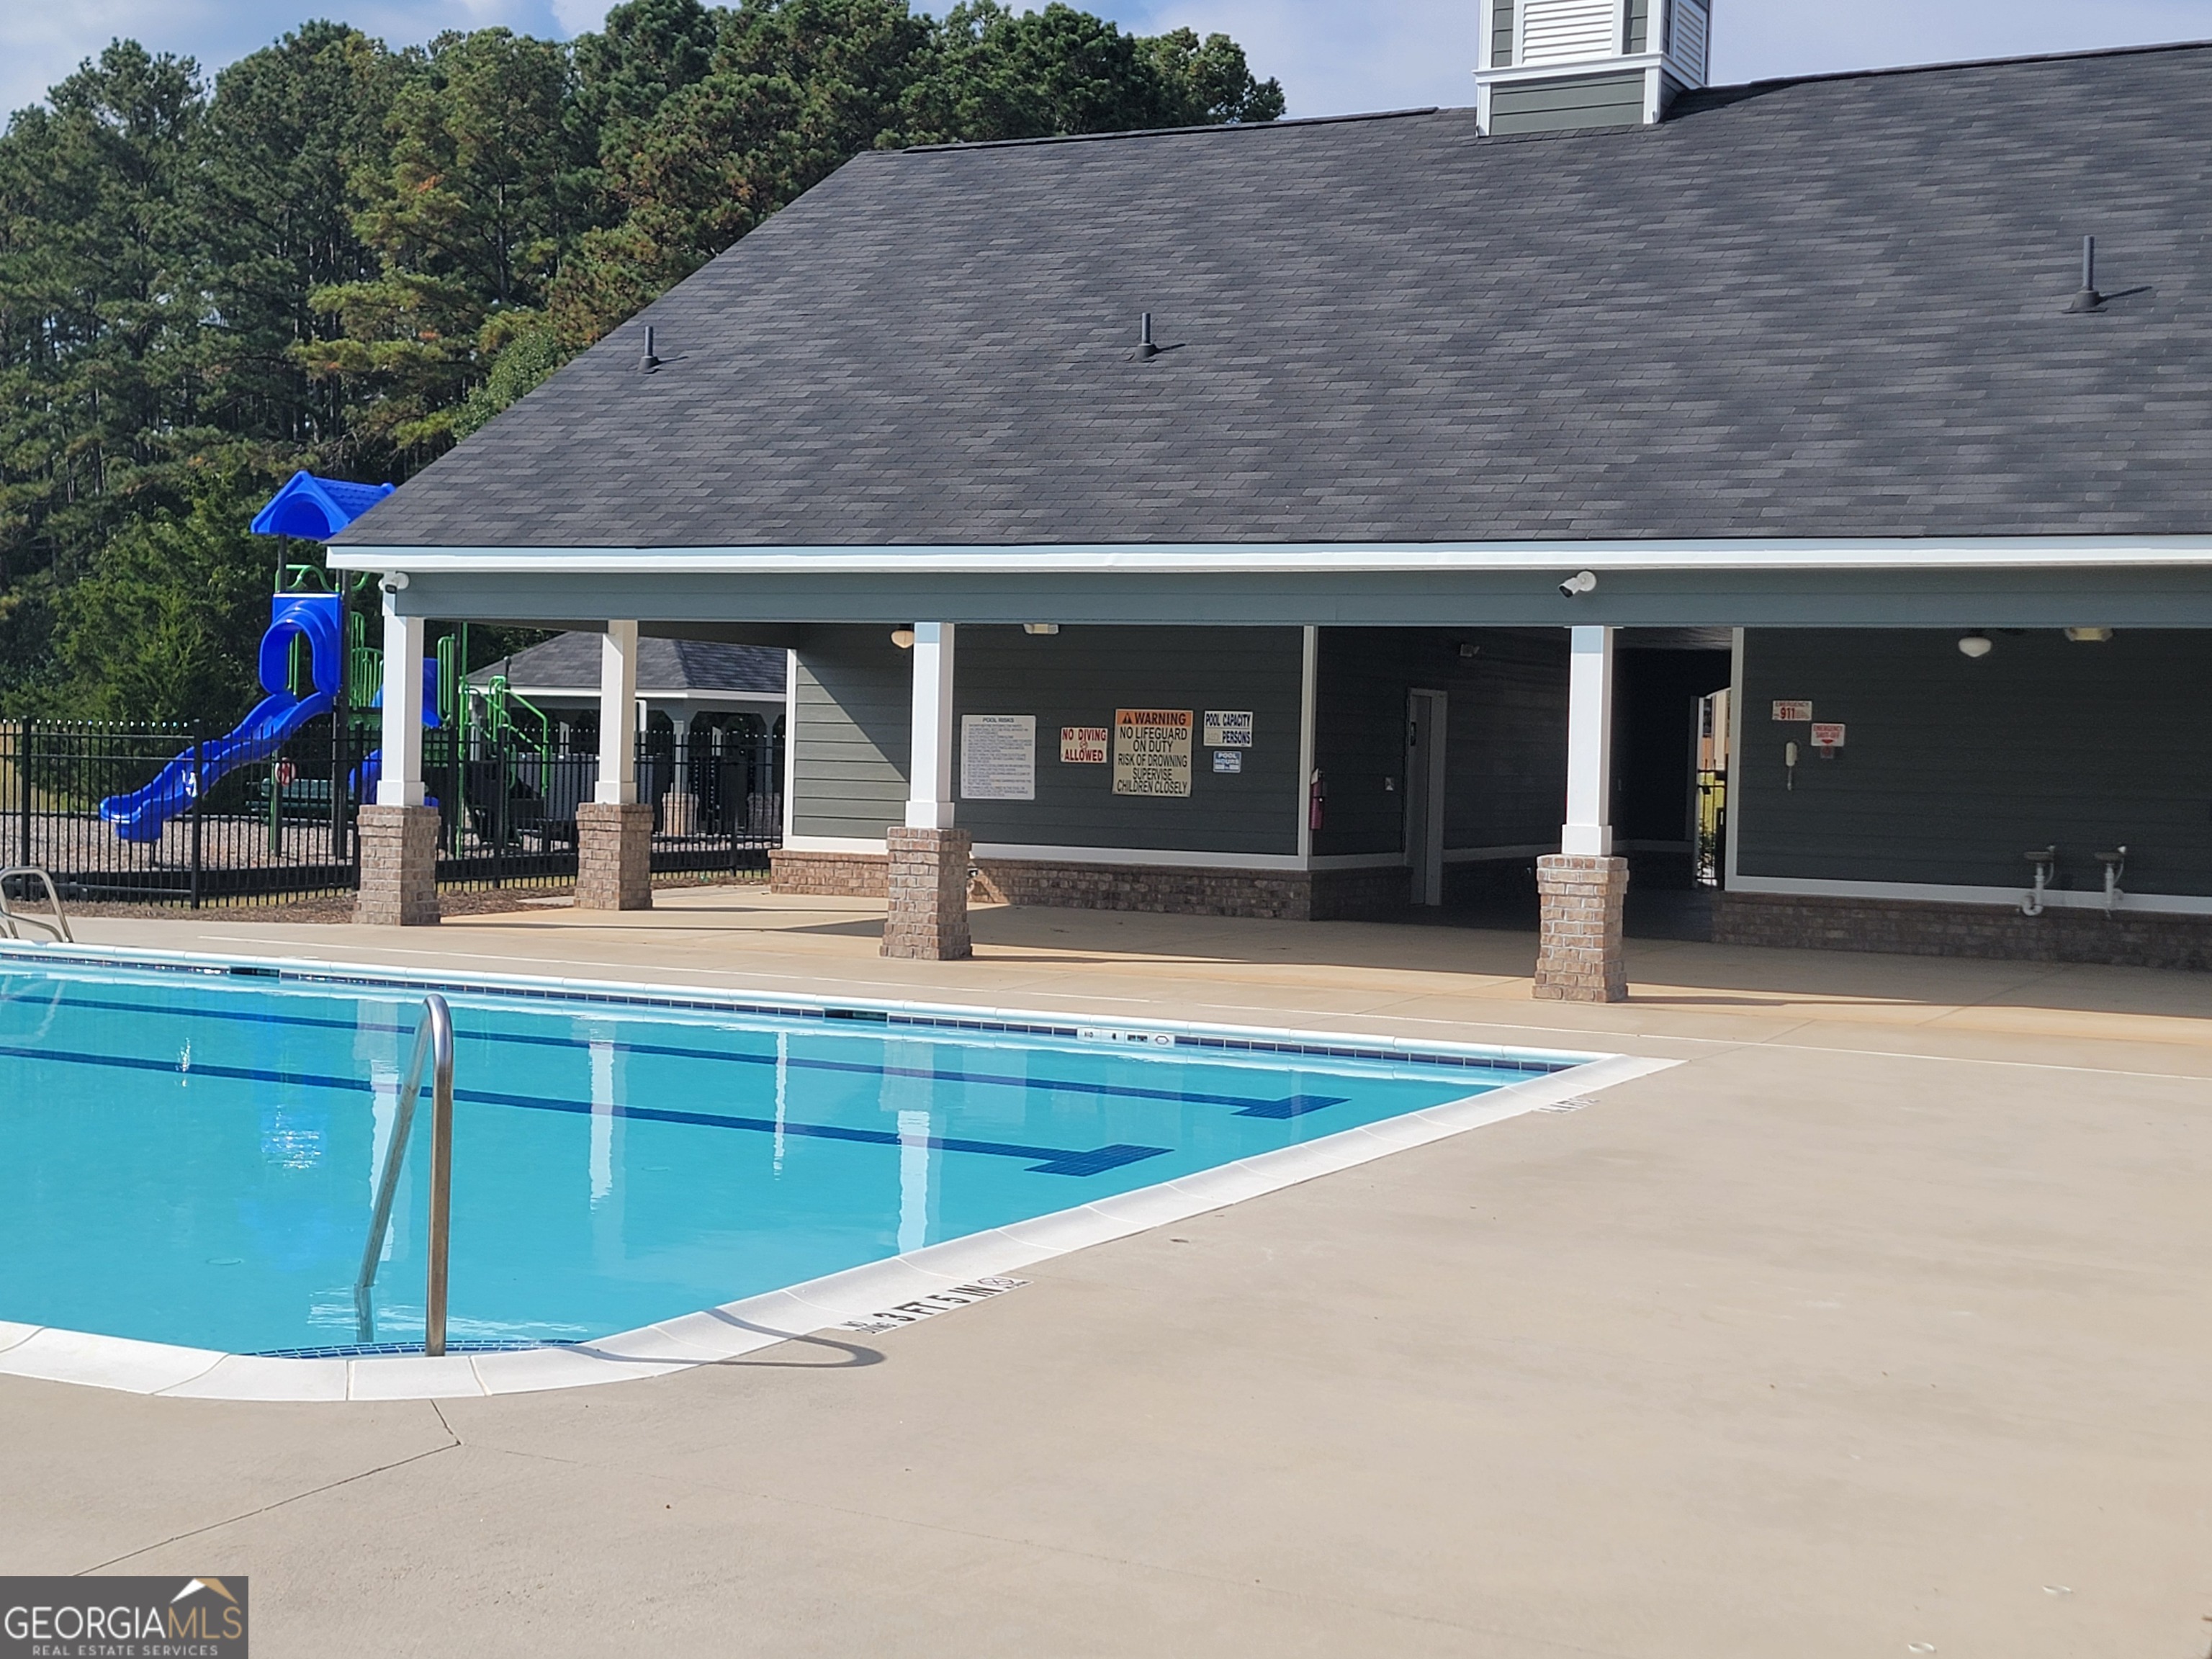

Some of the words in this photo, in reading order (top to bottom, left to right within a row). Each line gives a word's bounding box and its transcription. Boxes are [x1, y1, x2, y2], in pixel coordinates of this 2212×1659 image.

[1135, 712, 1186, 726] WARNING
[1780, 707, 1795, 719] 911
[1206, 713, 1220, 726] POOL
[1223, 714, 1251, 727] CAPACITY
[1062, 729, 1074, 740] NO
[1079, 729, 1106, 741] DIVING
[1120, 726, 1133, 739] NO
[1136, 727, 1187, 740] LIFEGUARD
[1223, 731, 1251, 744] PERSONS
[1133, 739, 1146, 752] ON
[1149, 740, 1173, 752] DUTY
[1064, 749, 1103, 761] ALLOWED
[1118, 753, 1135, 765] RISK
[1136, 754, 1146, 766] OF
[1148, 754, 1187, 768] DROWNING
[1133, 768, 1173, 781] SUPERVISE
[1118, 779, 1153, 792] CHILDREN
[1155, 781, 1187, 793] CLOSELY
[947, 1284, 1004, 1298] IN
[925, 1294, 971, 1304] 5
[891, 1301, 950, 1316] FT
[872, 1313, 917, 1321] 3
